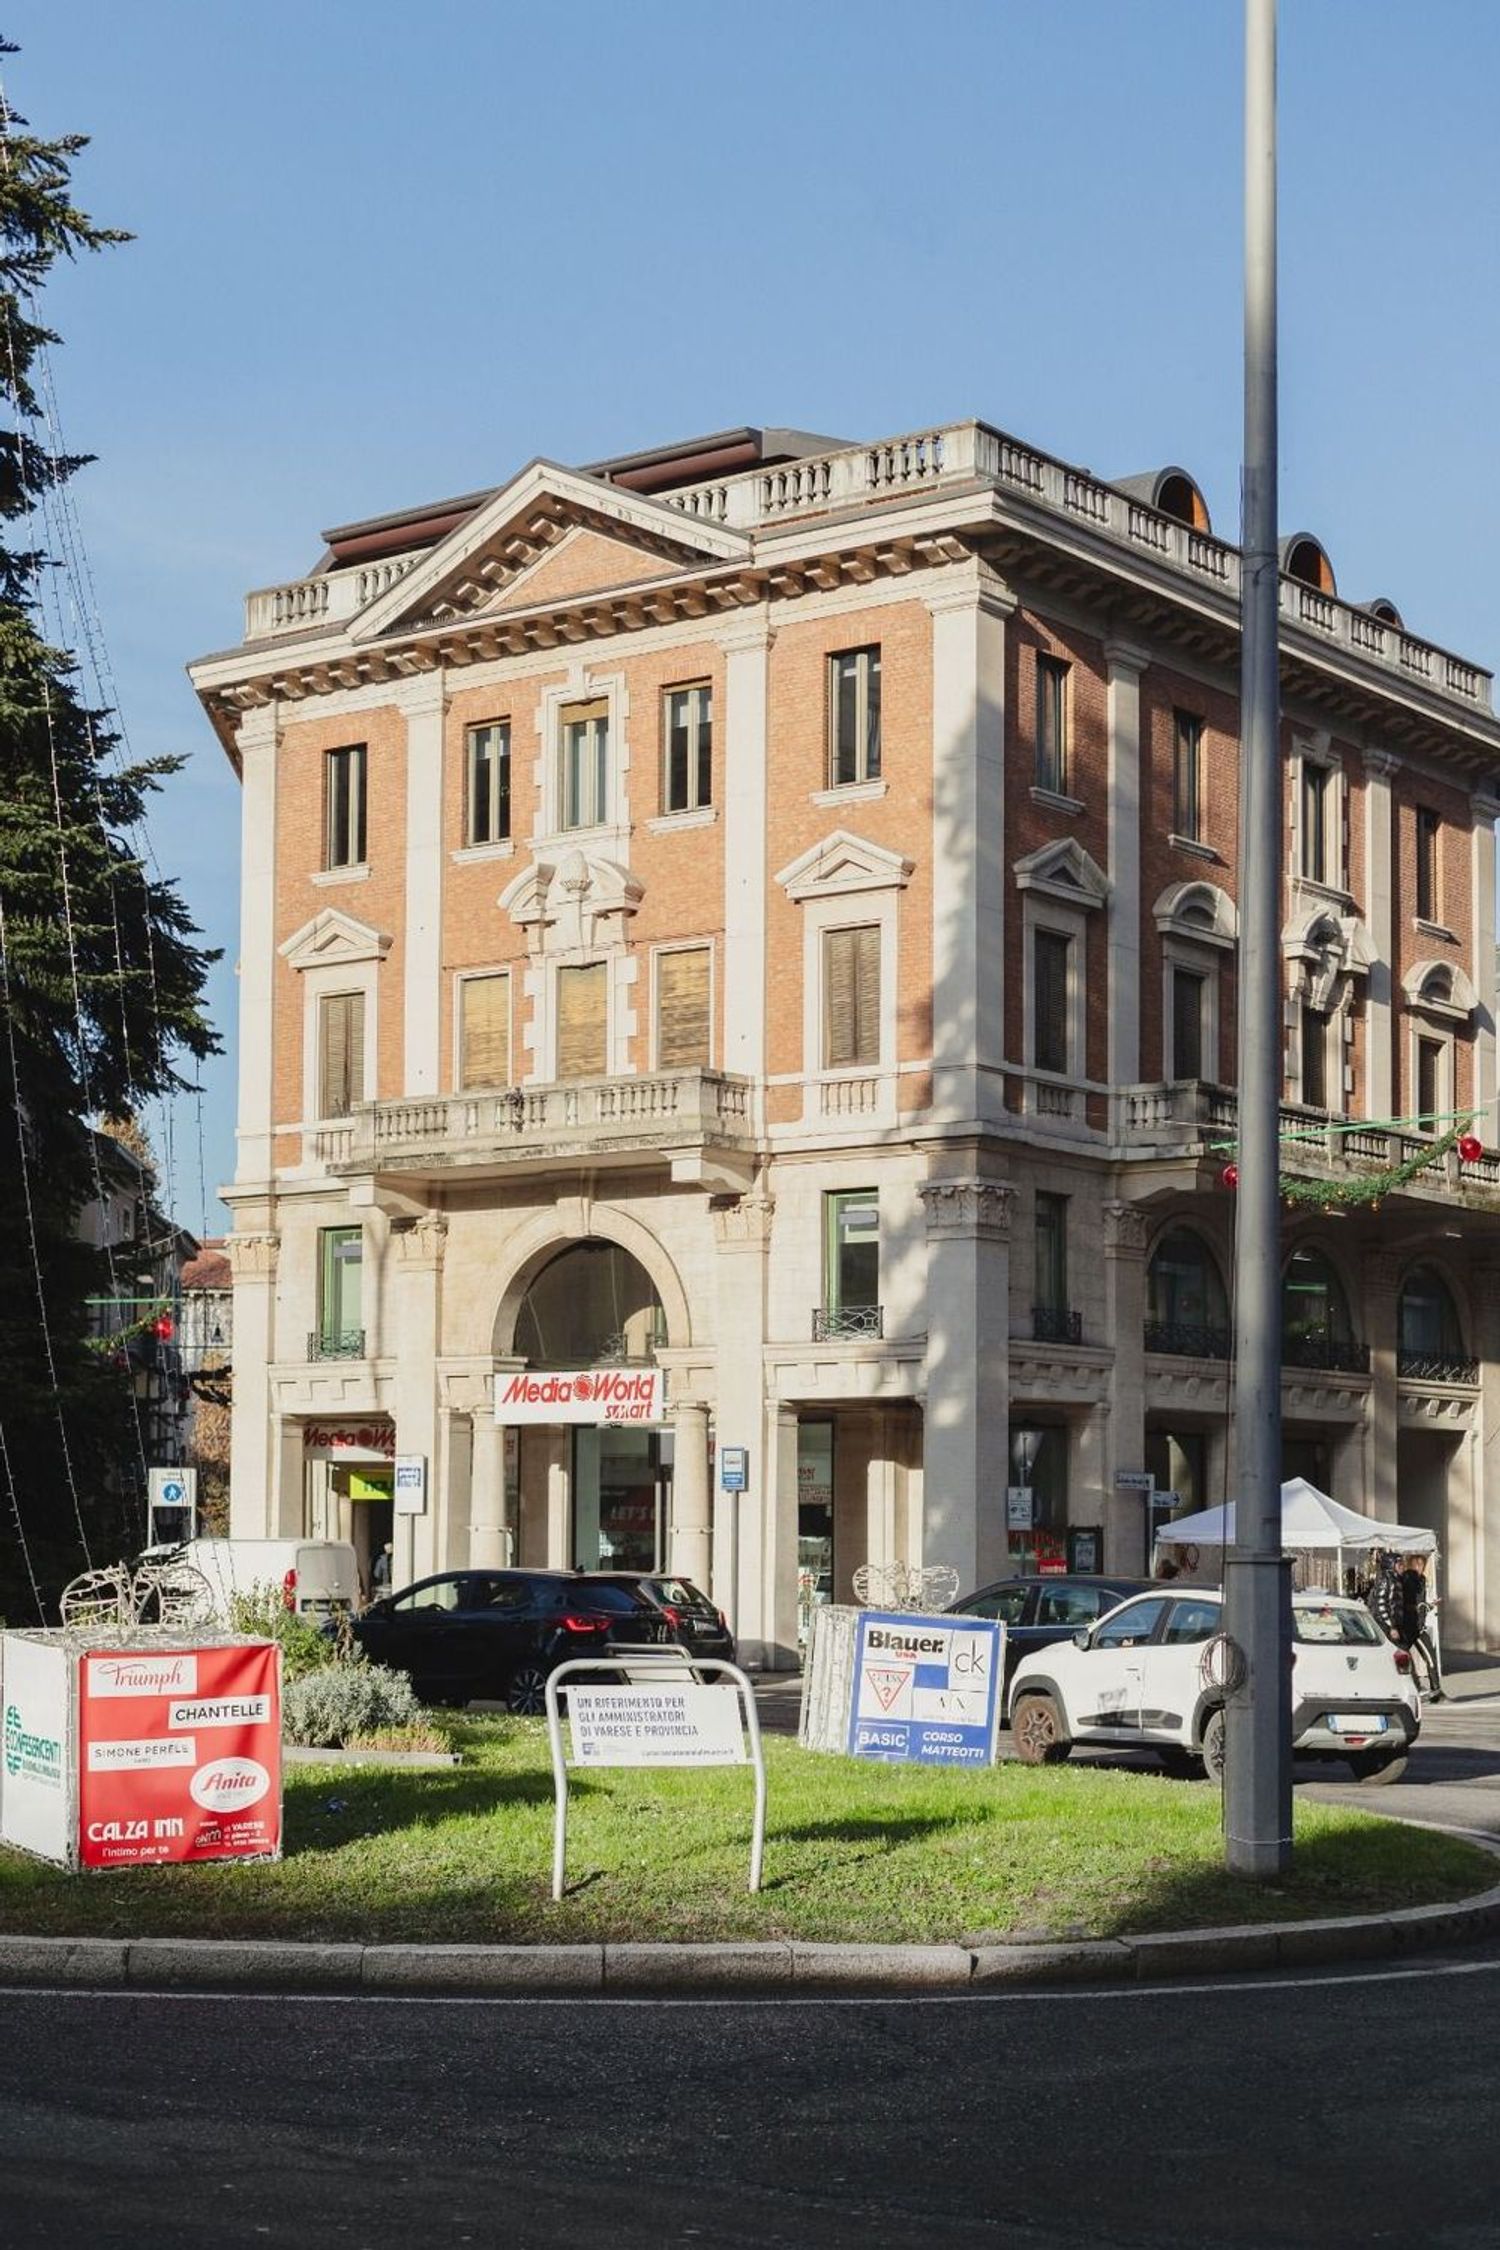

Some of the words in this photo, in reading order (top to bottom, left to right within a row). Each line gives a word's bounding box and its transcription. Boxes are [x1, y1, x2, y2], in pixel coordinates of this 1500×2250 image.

[503, 1377, 573, 1403] Media
[592, 1374, 655, 1401] World
[99, 1660, 184, 1694] Triumph
[577, 1698, 592, 1708] UN
[665, 1697, 685, 1708] PER
[175, 1703, 264, 1722] CHANTELLE
[580, 1726, 592, 1737] DI
[594, 1726, 633, 1737] VARESE
[635, 1726, 641, 1736] E
[644, 1725, 699, 1736] PROVINCIA
[858, 1731, 906, 1748] BASIC
[922, 1731, 963, 1743] CORSO
[95, 1747, 141, 1758] SIMONE
[921, 1745, 984, 1758] MATTEOTTI
[202, 1771, 257, 1792] Anita
[88, 1821, 149, 1842] CALZA
